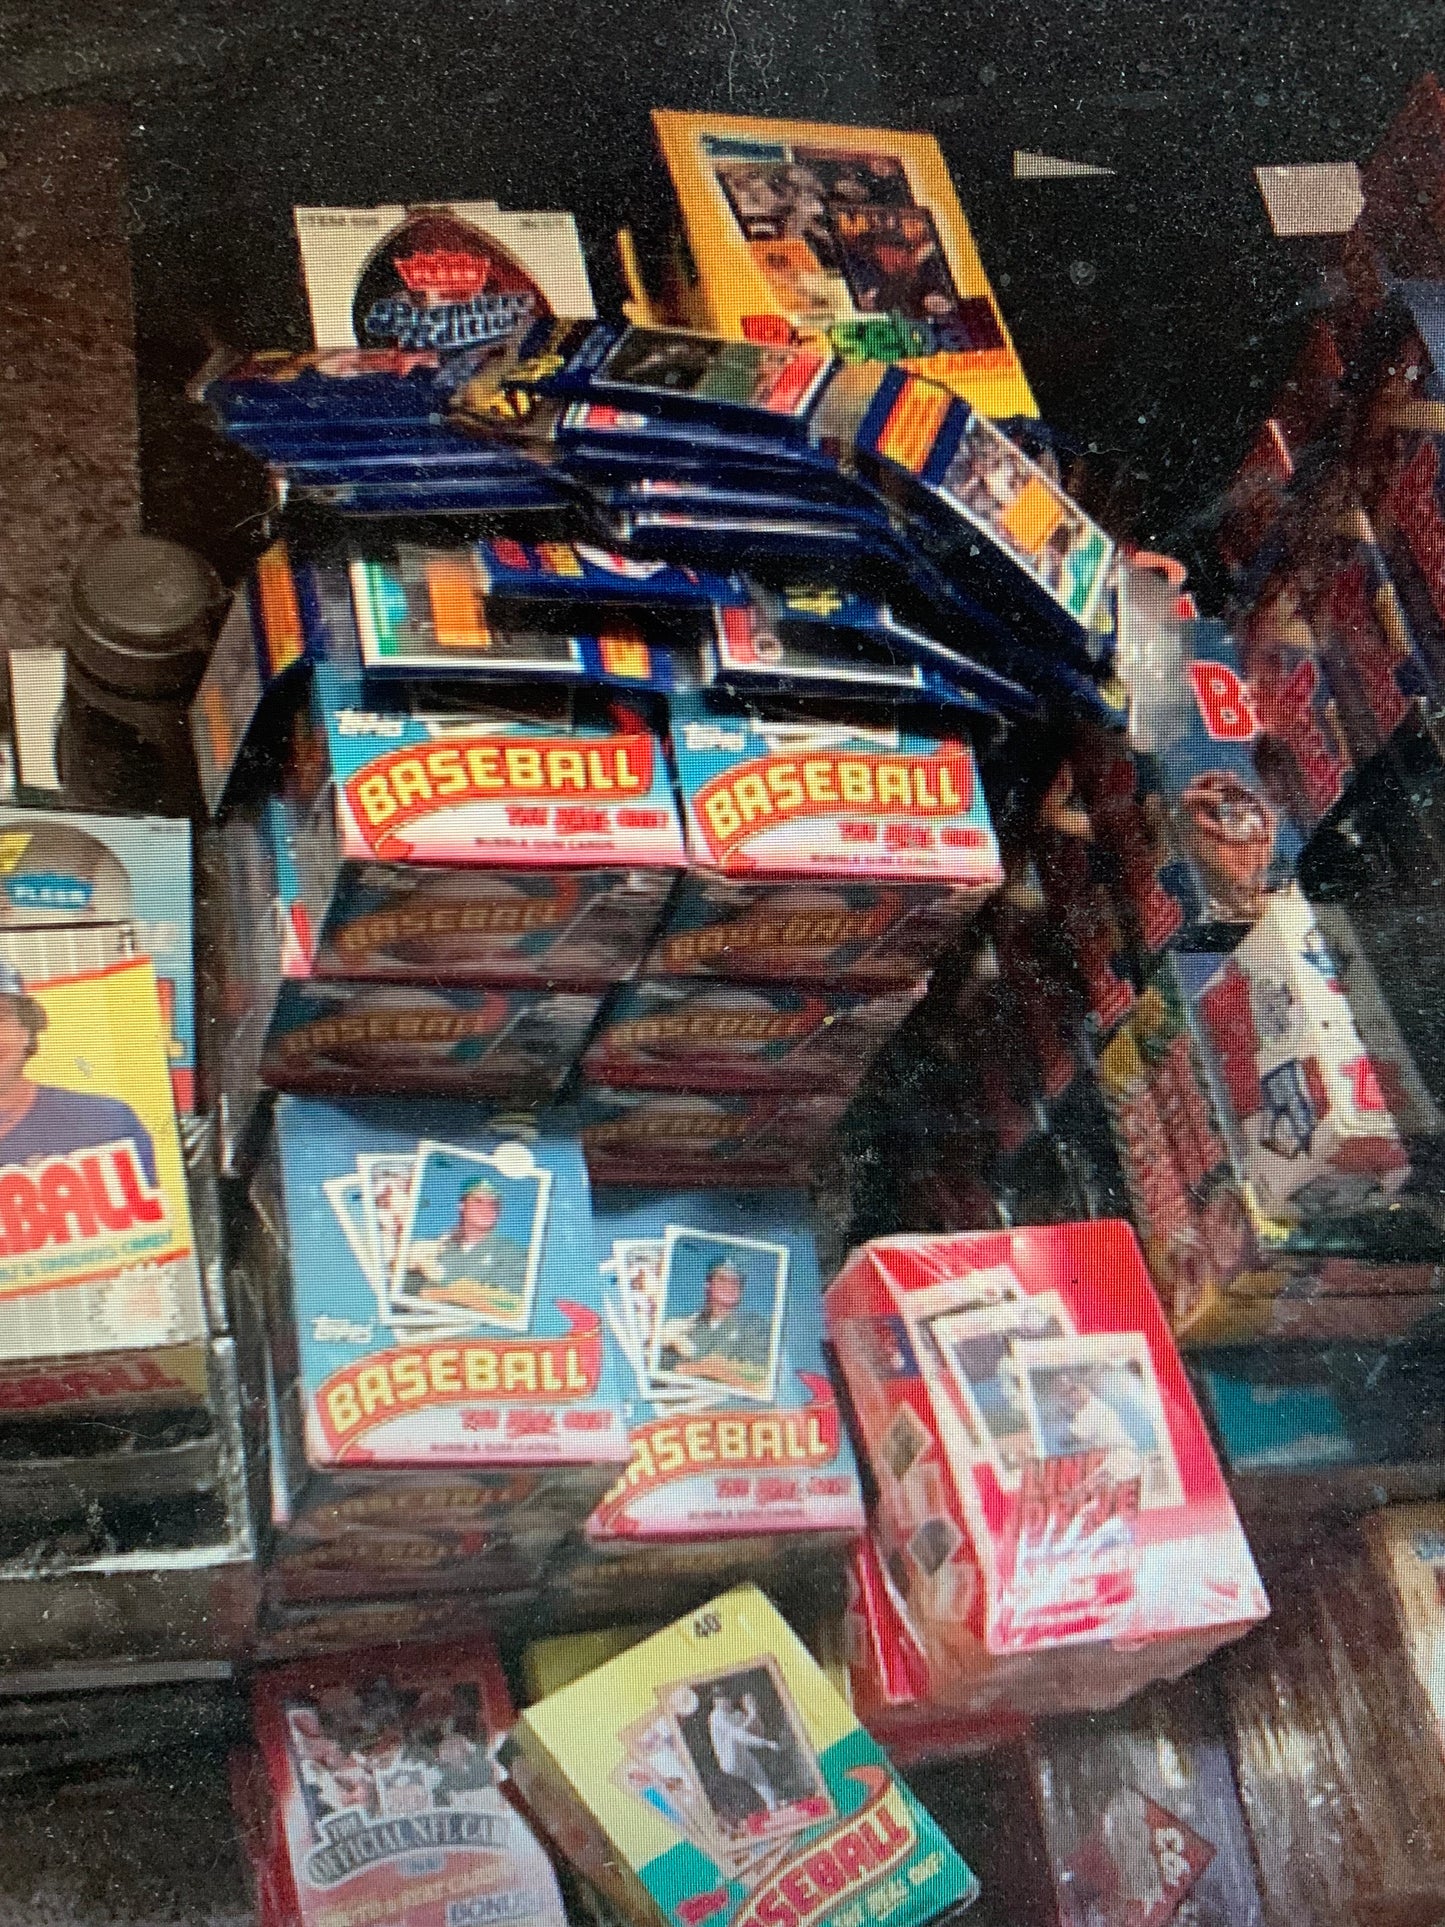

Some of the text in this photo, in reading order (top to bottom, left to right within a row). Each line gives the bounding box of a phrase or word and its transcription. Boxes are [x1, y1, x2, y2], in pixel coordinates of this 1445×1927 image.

[357, 748, 640, 826] BASEBALL
[704, 760, 961, 840] BASEBALL
[0, 1150, 163, 1256] BALL
[326, 1348, 588, 1433] BASEBALL
[310, 1822, 409, 1885] OFFICIAL
[409, 1813, 460, 1846] NFL
